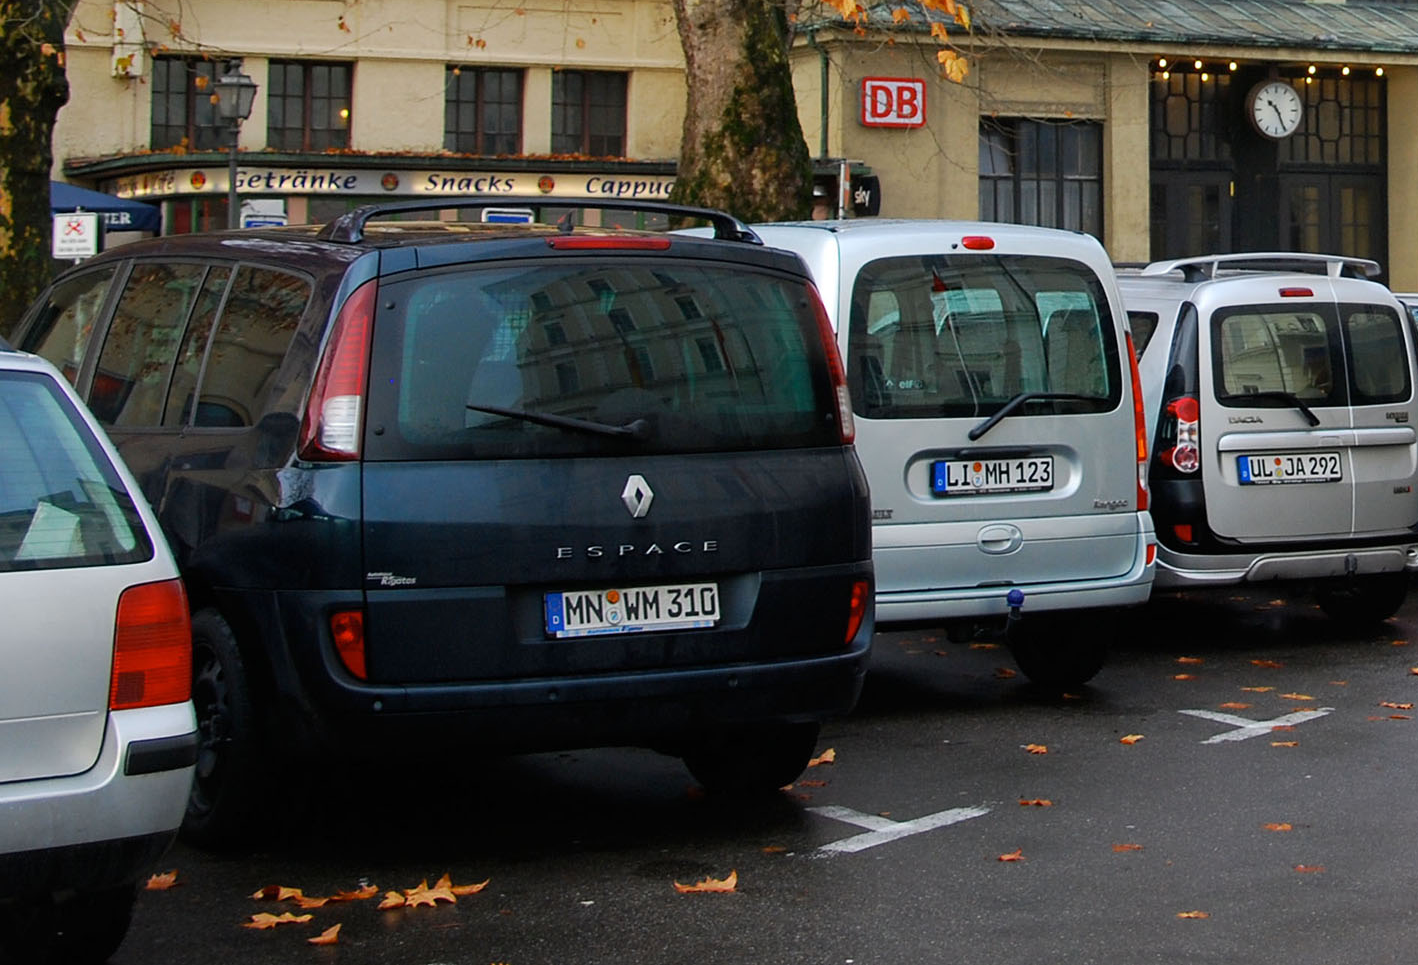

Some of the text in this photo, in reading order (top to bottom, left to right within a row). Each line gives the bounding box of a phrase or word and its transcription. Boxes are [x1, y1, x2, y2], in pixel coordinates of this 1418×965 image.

[870, 85, 918, 119] DB
[235, 169, 358, 190] Getränke
[424, 173, 515, 193] Snacks
[854, 186, 871, 207] sky
[946, 464, 971, 486] LI
[985, 462, 1011, 485] MH
[1016, 461, 1051, 483] 123
[1250, 456, 1339, 478] UL JA 292
[556, 540, 718, 559] ESPACE
[552, 586, 716, 626] D MN WM 310
